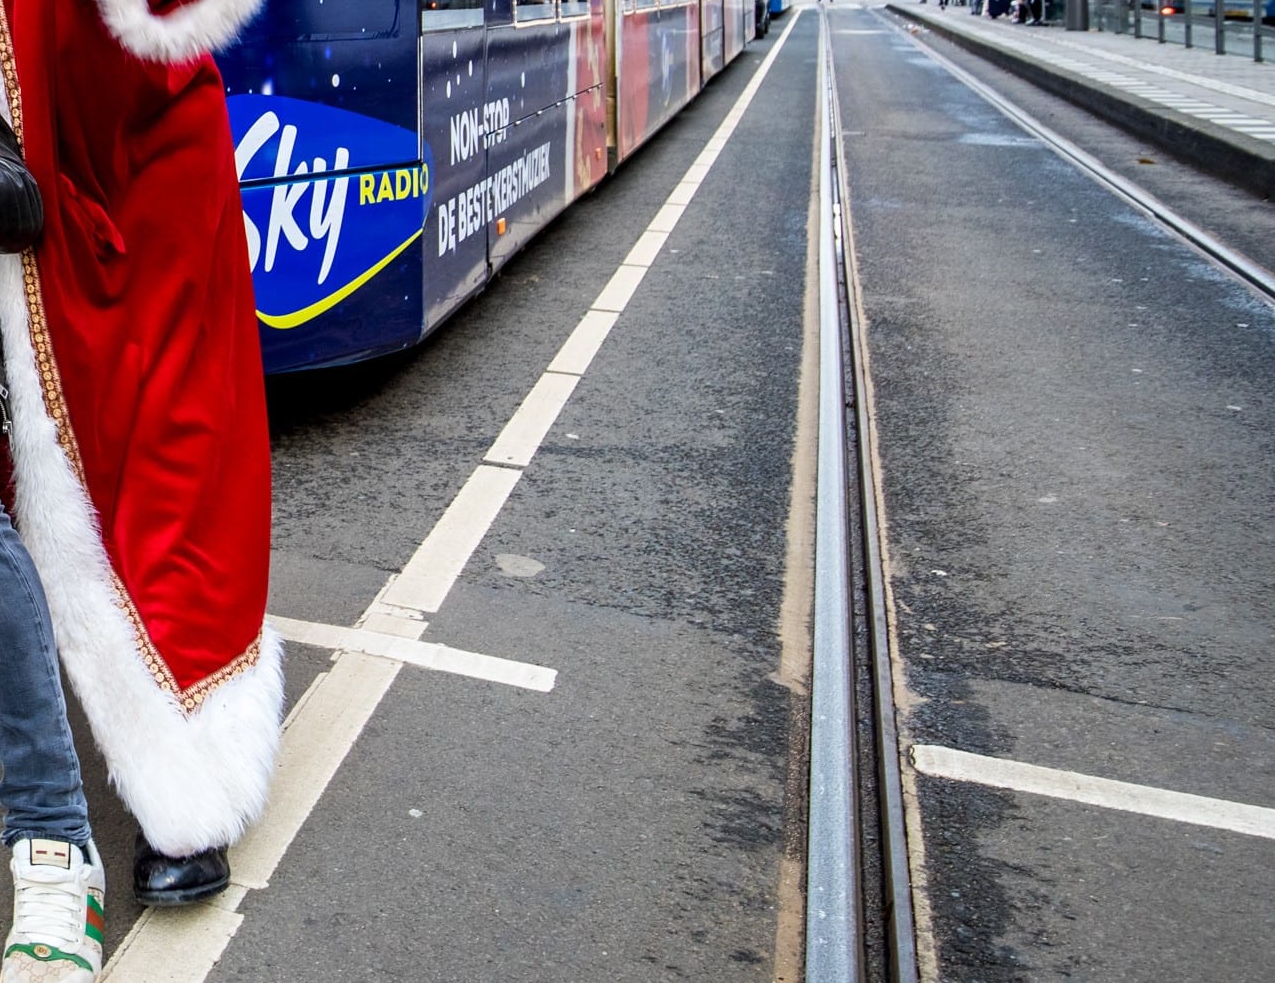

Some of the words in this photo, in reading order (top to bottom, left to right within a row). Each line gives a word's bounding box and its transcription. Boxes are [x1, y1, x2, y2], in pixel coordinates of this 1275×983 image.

[451, 97, 510, 166] NON-STOP
[234, 111, 349, 285] Sky
[359, 163, 429, 205] RADIO
[438, 198, 456, 258] DE
[458, 176, 493, 242] BESTE
[494, 141, 551, 218] KERSTMUZIEK
